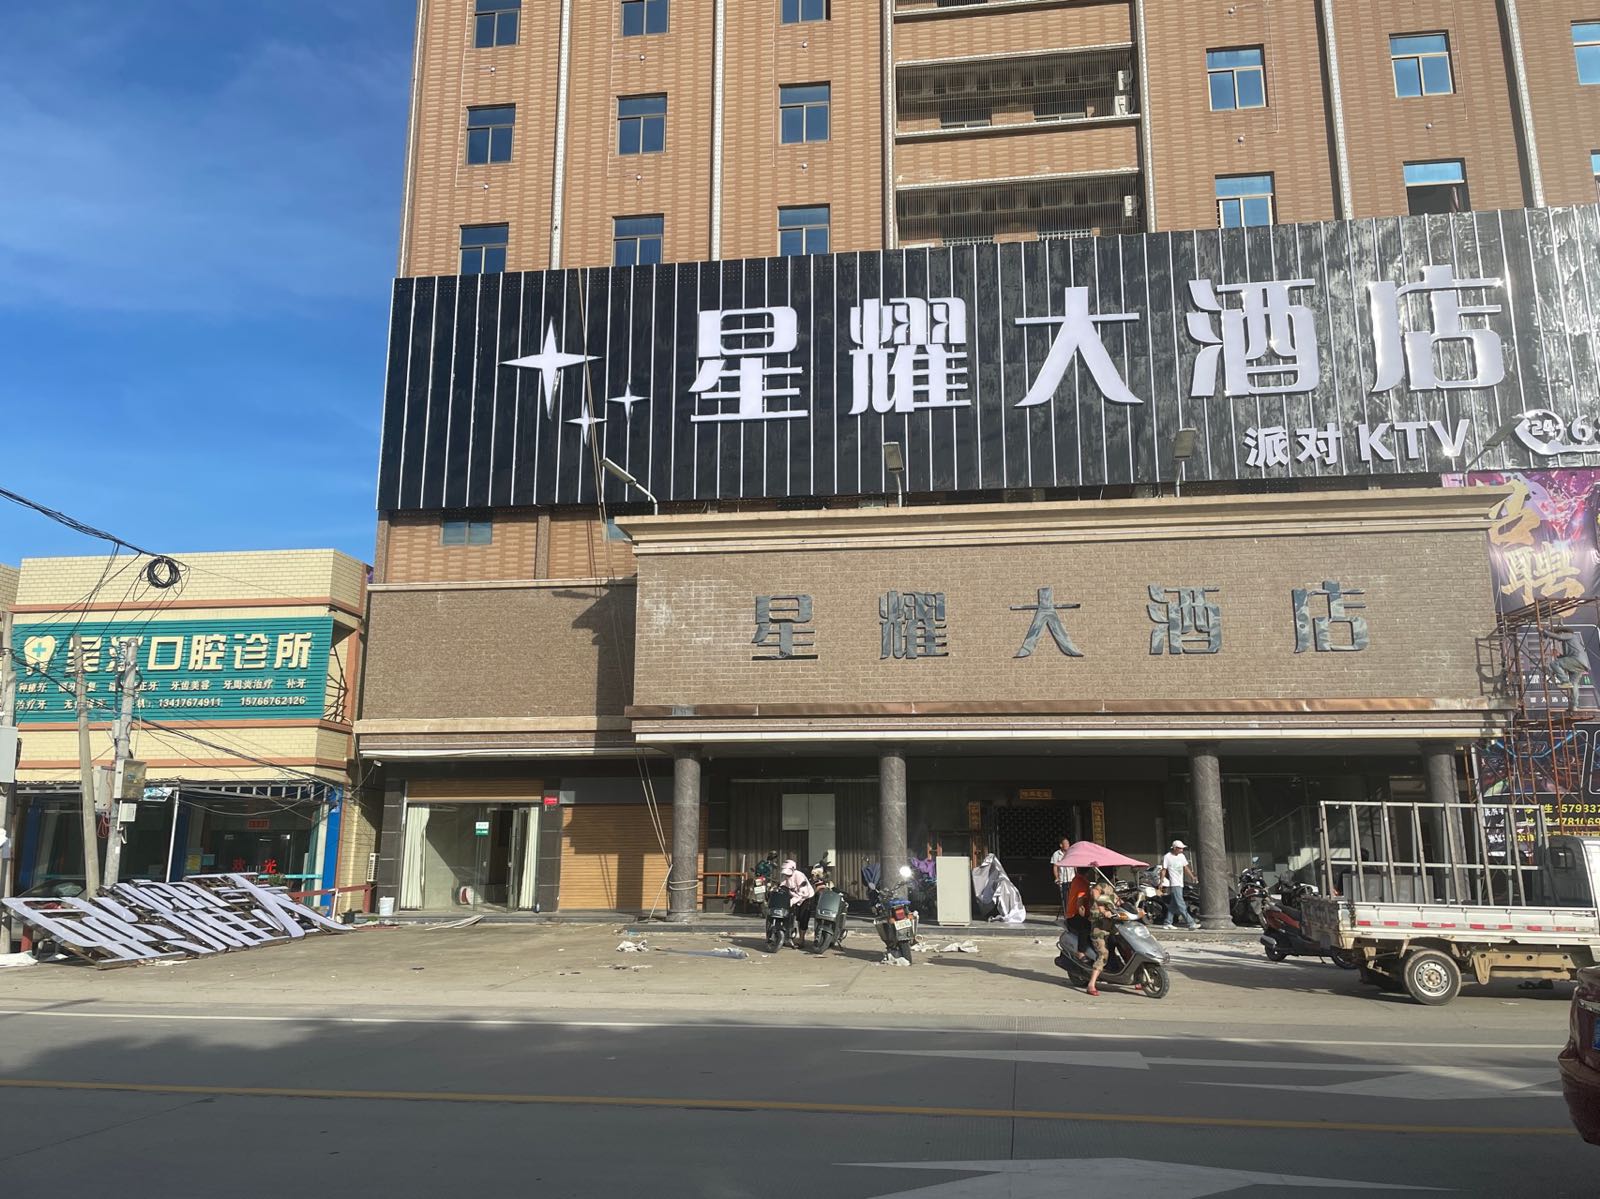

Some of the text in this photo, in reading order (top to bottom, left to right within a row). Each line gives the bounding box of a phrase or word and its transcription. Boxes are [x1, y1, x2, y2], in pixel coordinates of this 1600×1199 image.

[688, 264, 1505, 422] 星耀大酒店
[1244, 418, 1470, 467] 派对 KTV
[751, 580, 1370, 660] 星耀大酒店
[241, 697, 307, 707] 15766762126
